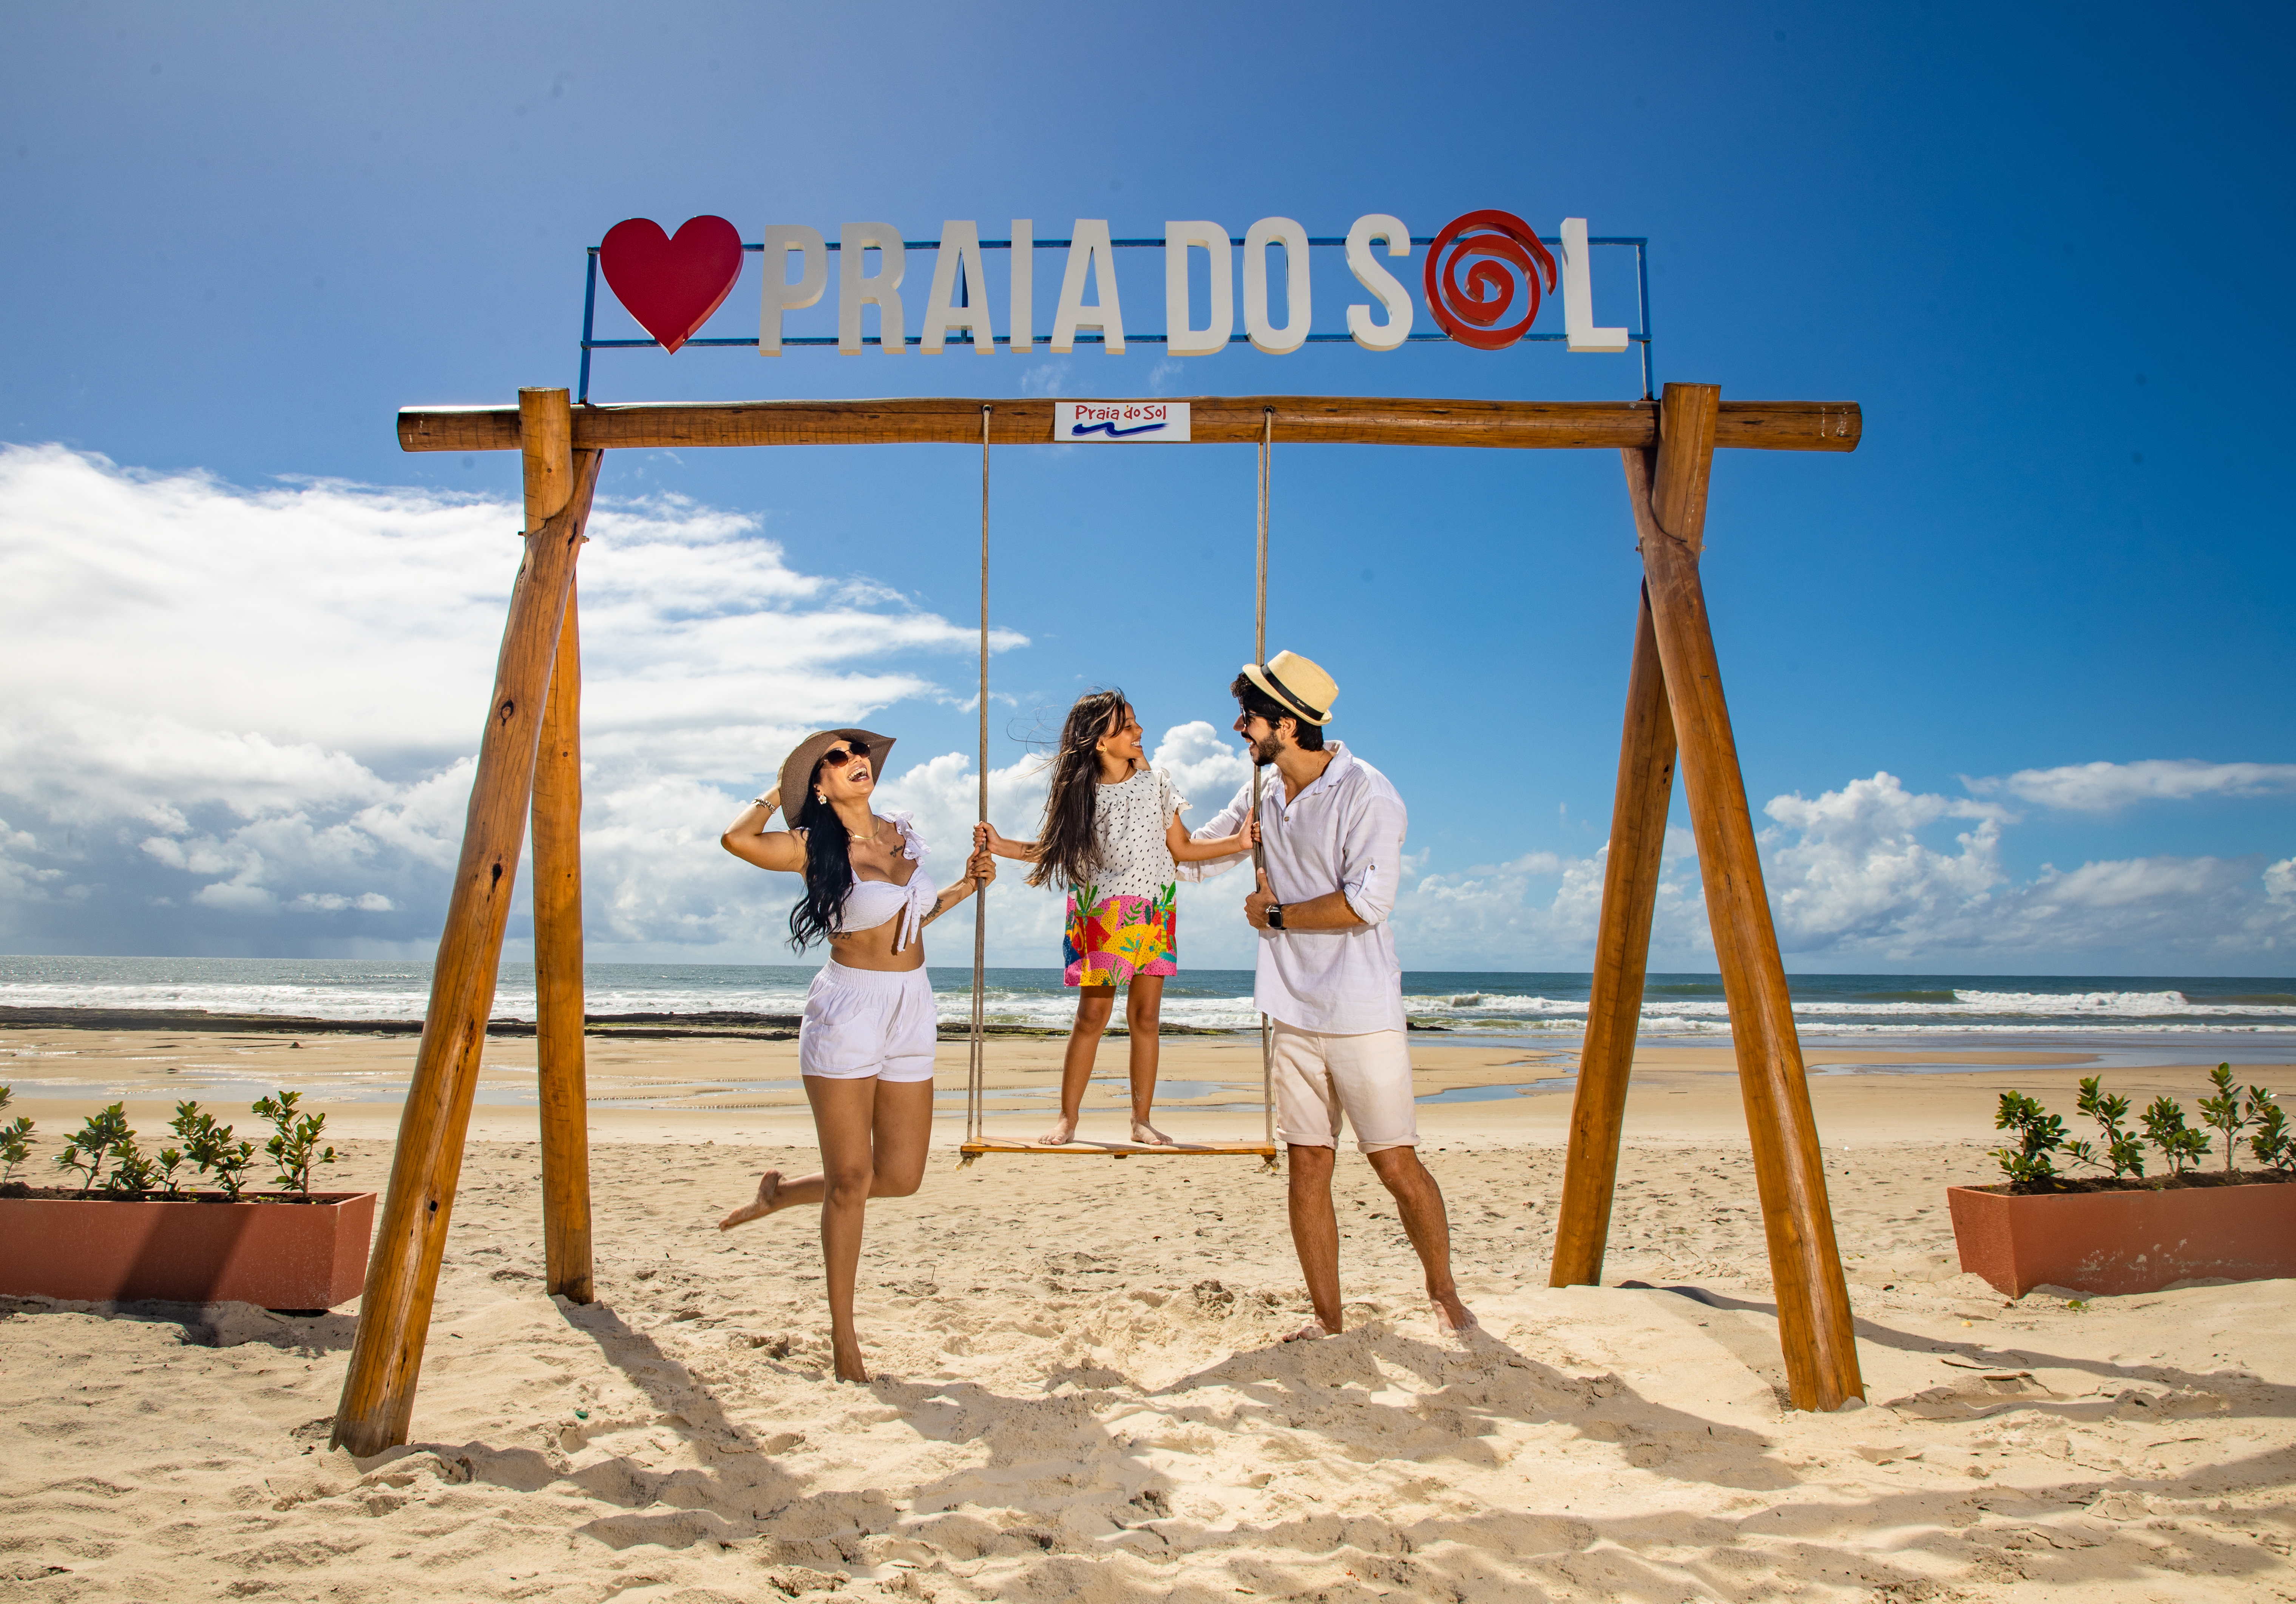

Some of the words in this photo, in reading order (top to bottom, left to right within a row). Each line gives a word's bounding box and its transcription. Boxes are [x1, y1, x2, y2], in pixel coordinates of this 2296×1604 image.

[758, 218, 1126, 357] PRAIA
[1165, 217, 1311, 356] DO
[1345, 209, 1629, 353] SOL
[1075, 405, 1119, 420] Praia
[1124, 407, 1141, 420] do
[1143, 405, 1166, 420] Sol
